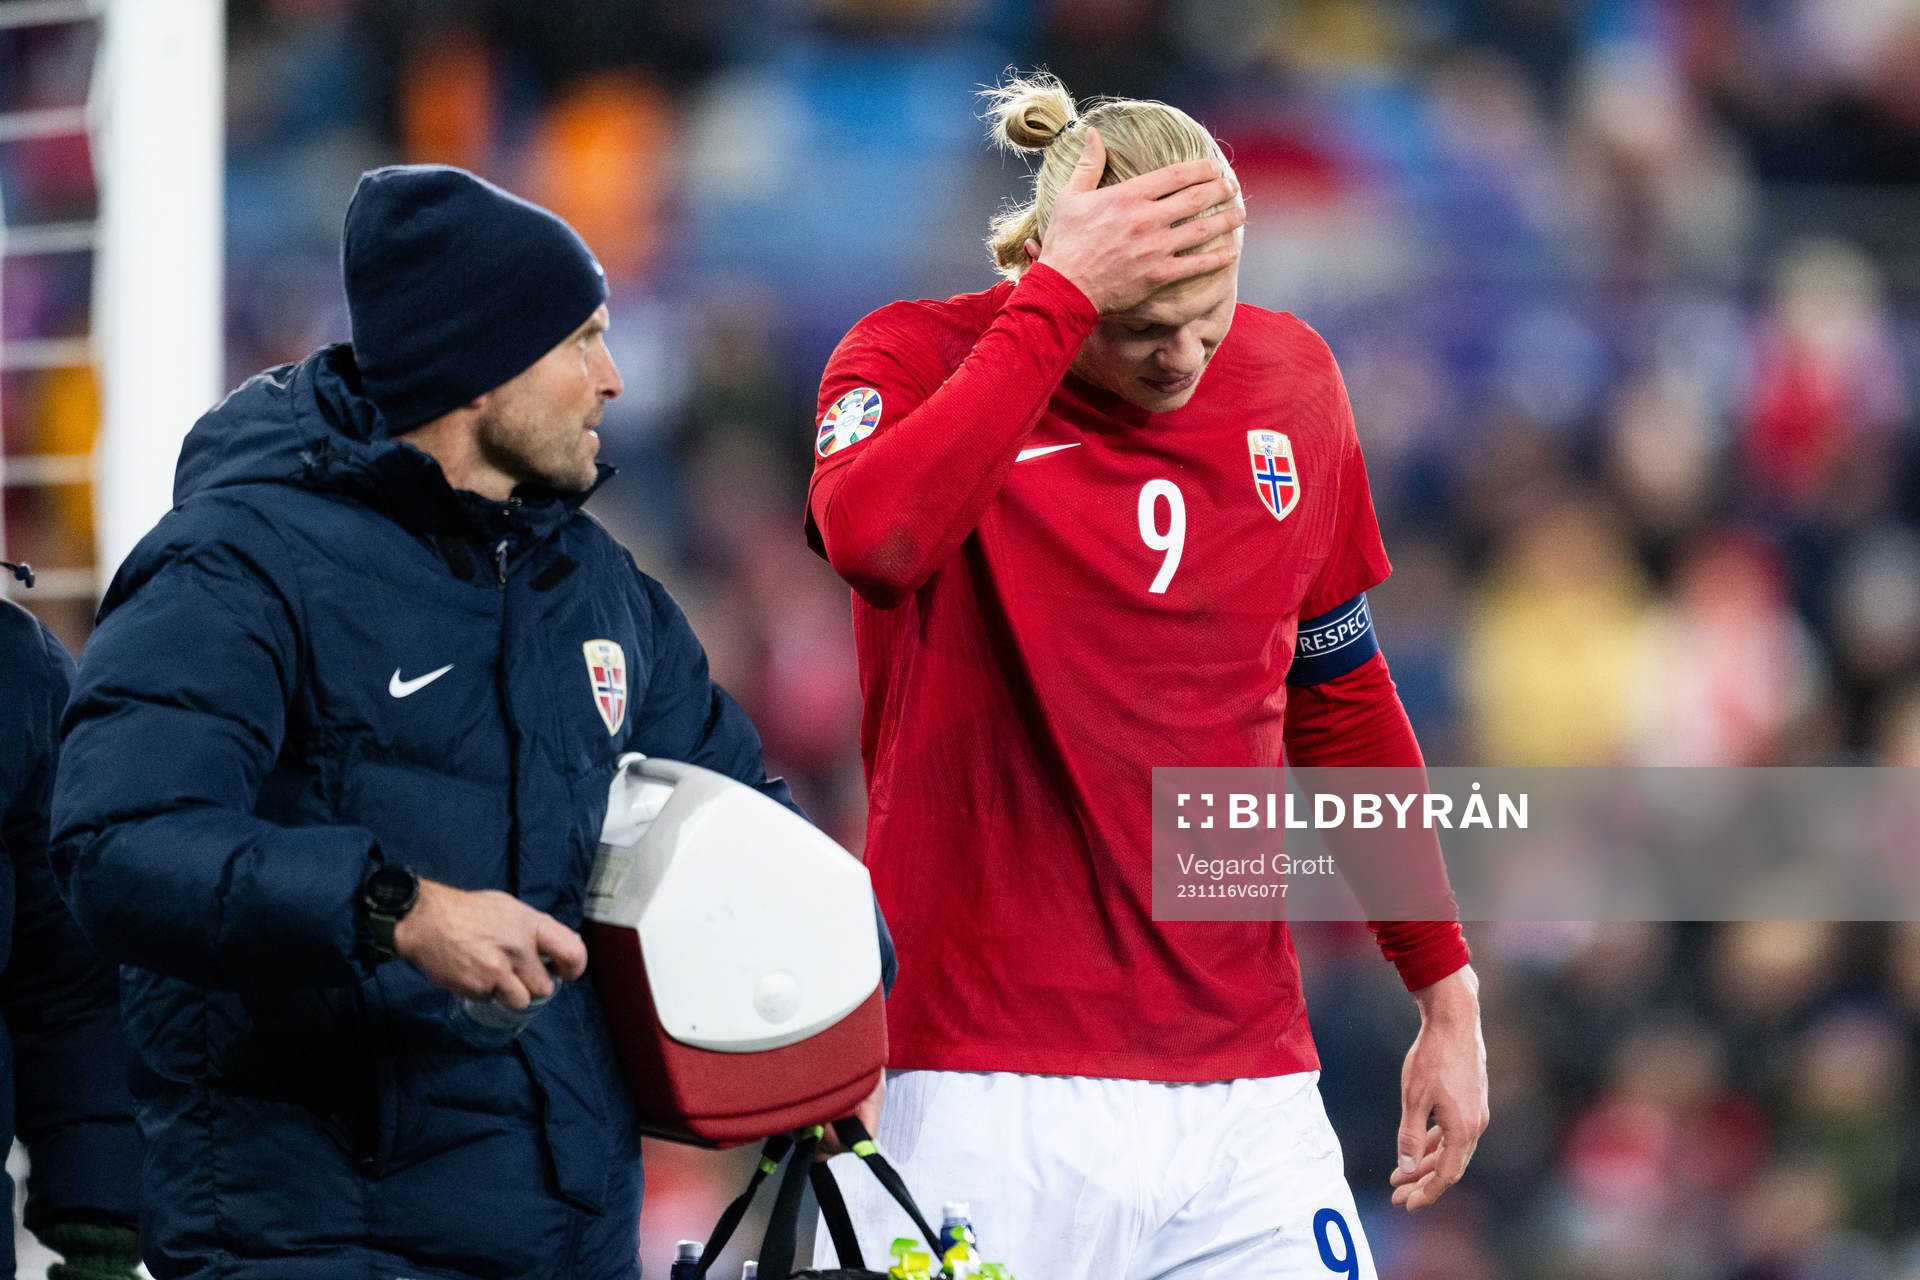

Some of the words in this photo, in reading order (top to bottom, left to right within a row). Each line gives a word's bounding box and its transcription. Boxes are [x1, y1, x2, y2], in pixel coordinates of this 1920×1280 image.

[1138, 479, 1186, 594] 9
[1299, 604, 1369, 652] RESPECT
[1313, 1207, 1359, 1280] 9
